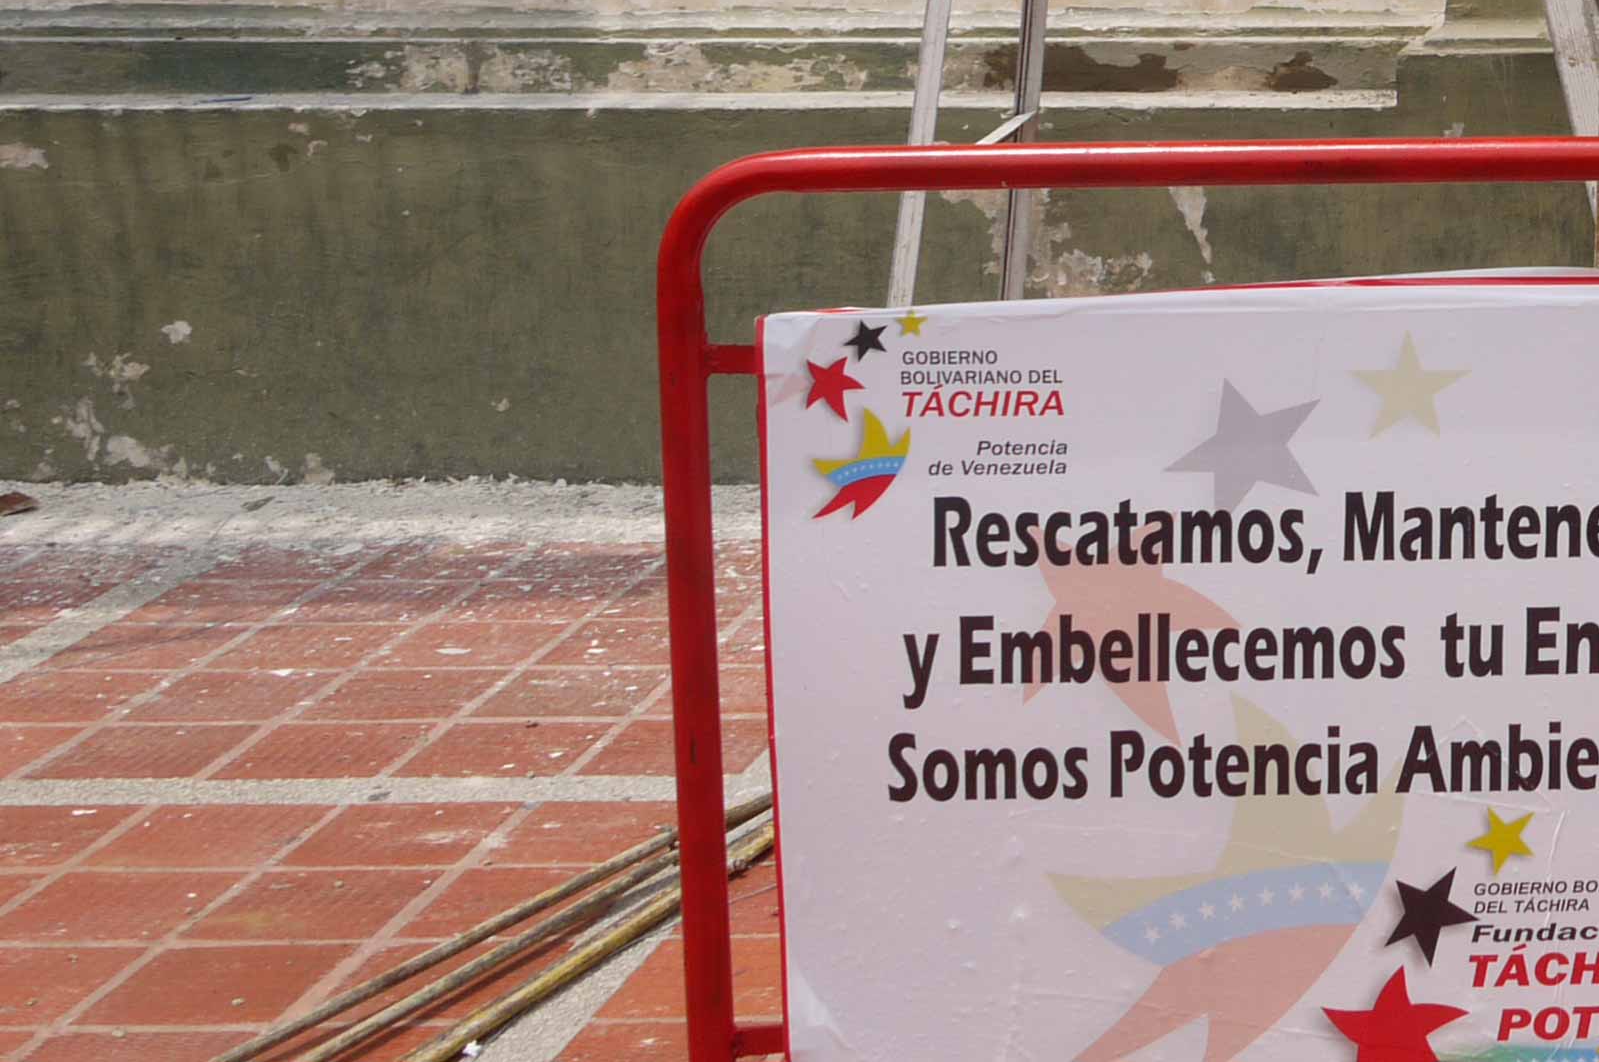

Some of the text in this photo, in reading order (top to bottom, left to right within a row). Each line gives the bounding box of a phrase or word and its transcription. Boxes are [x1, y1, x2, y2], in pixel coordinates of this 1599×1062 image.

[902, 350, 998, 365] GOBIERNO
[900, 369, 1063, 385] BOLIVARIANO DEL
[901, 384, 1065, 418] TÁCHIRA
[976, 440, 1068, 456] Potencia
[928, 459, 1067, 476] de Venezuela
[933, 495, 1323, 575] Rescatamos,
[902, 633, 940, 710] y
[959, 612, 1406, 685] Embellecemos
[1440, 612, 1504, 678] tu
[887, 732, 1089, 803] Somos
[1110, 725, 1378, 799] Potencia
[1473, 881, 1568, 896] GOBIERNO
[1473, 896, 1590, 914] DEL TÁCHIRA
